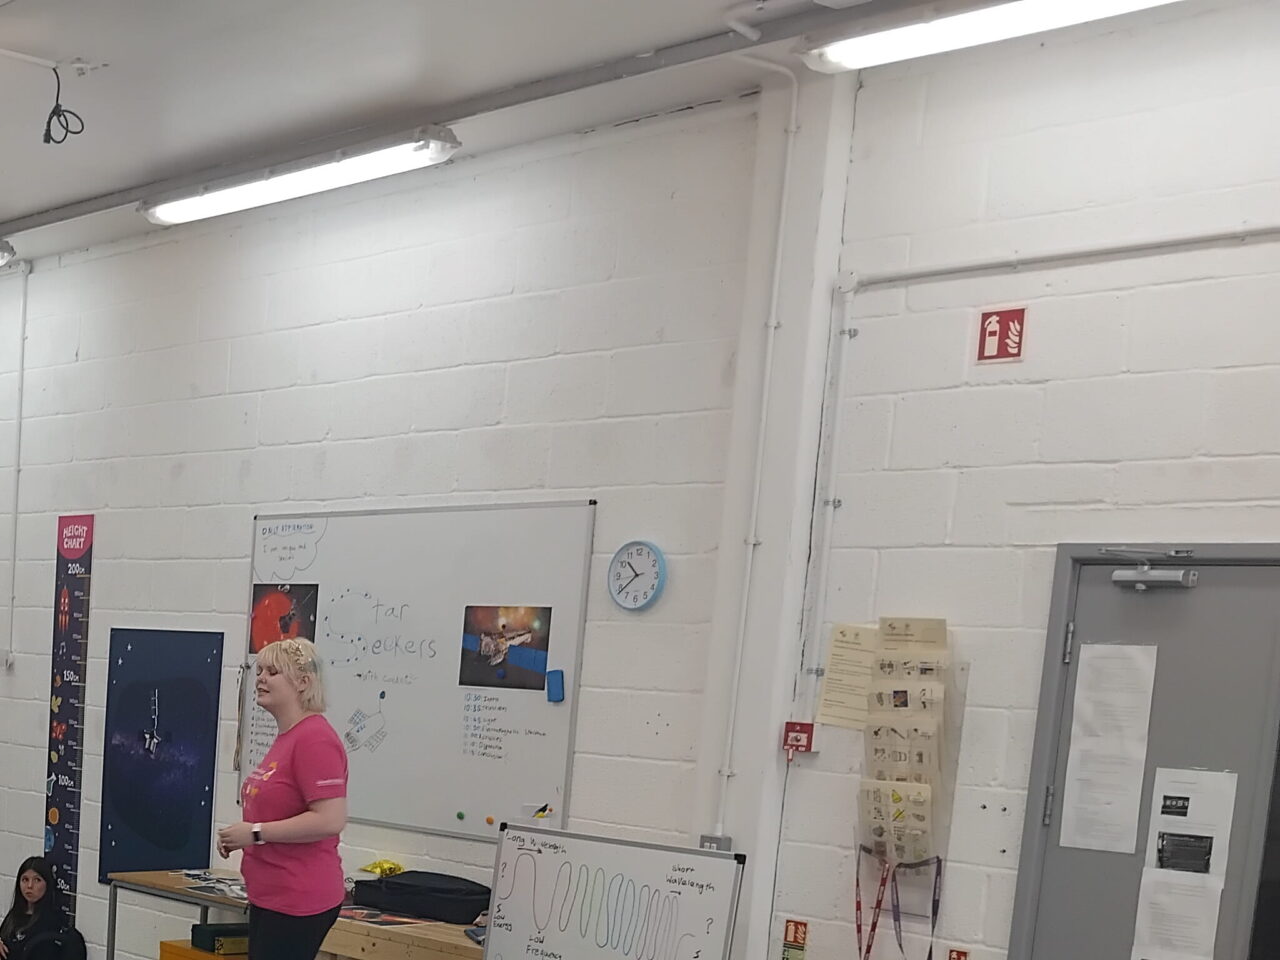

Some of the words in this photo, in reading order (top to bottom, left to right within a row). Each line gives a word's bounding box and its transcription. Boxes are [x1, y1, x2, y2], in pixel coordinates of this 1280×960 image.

[63, 525, 88, 539] HEIGHT
[63, 538, 85, 549] CHART
[636, 548, 643, 556] 12
[620, 560, 627, 568] 10
[505, 830, 525, 847] Long
[530, 836, 567, 854] Wvelength
[671, 863, 695, 873] Short
[492, 920, 513, 932] Energy
